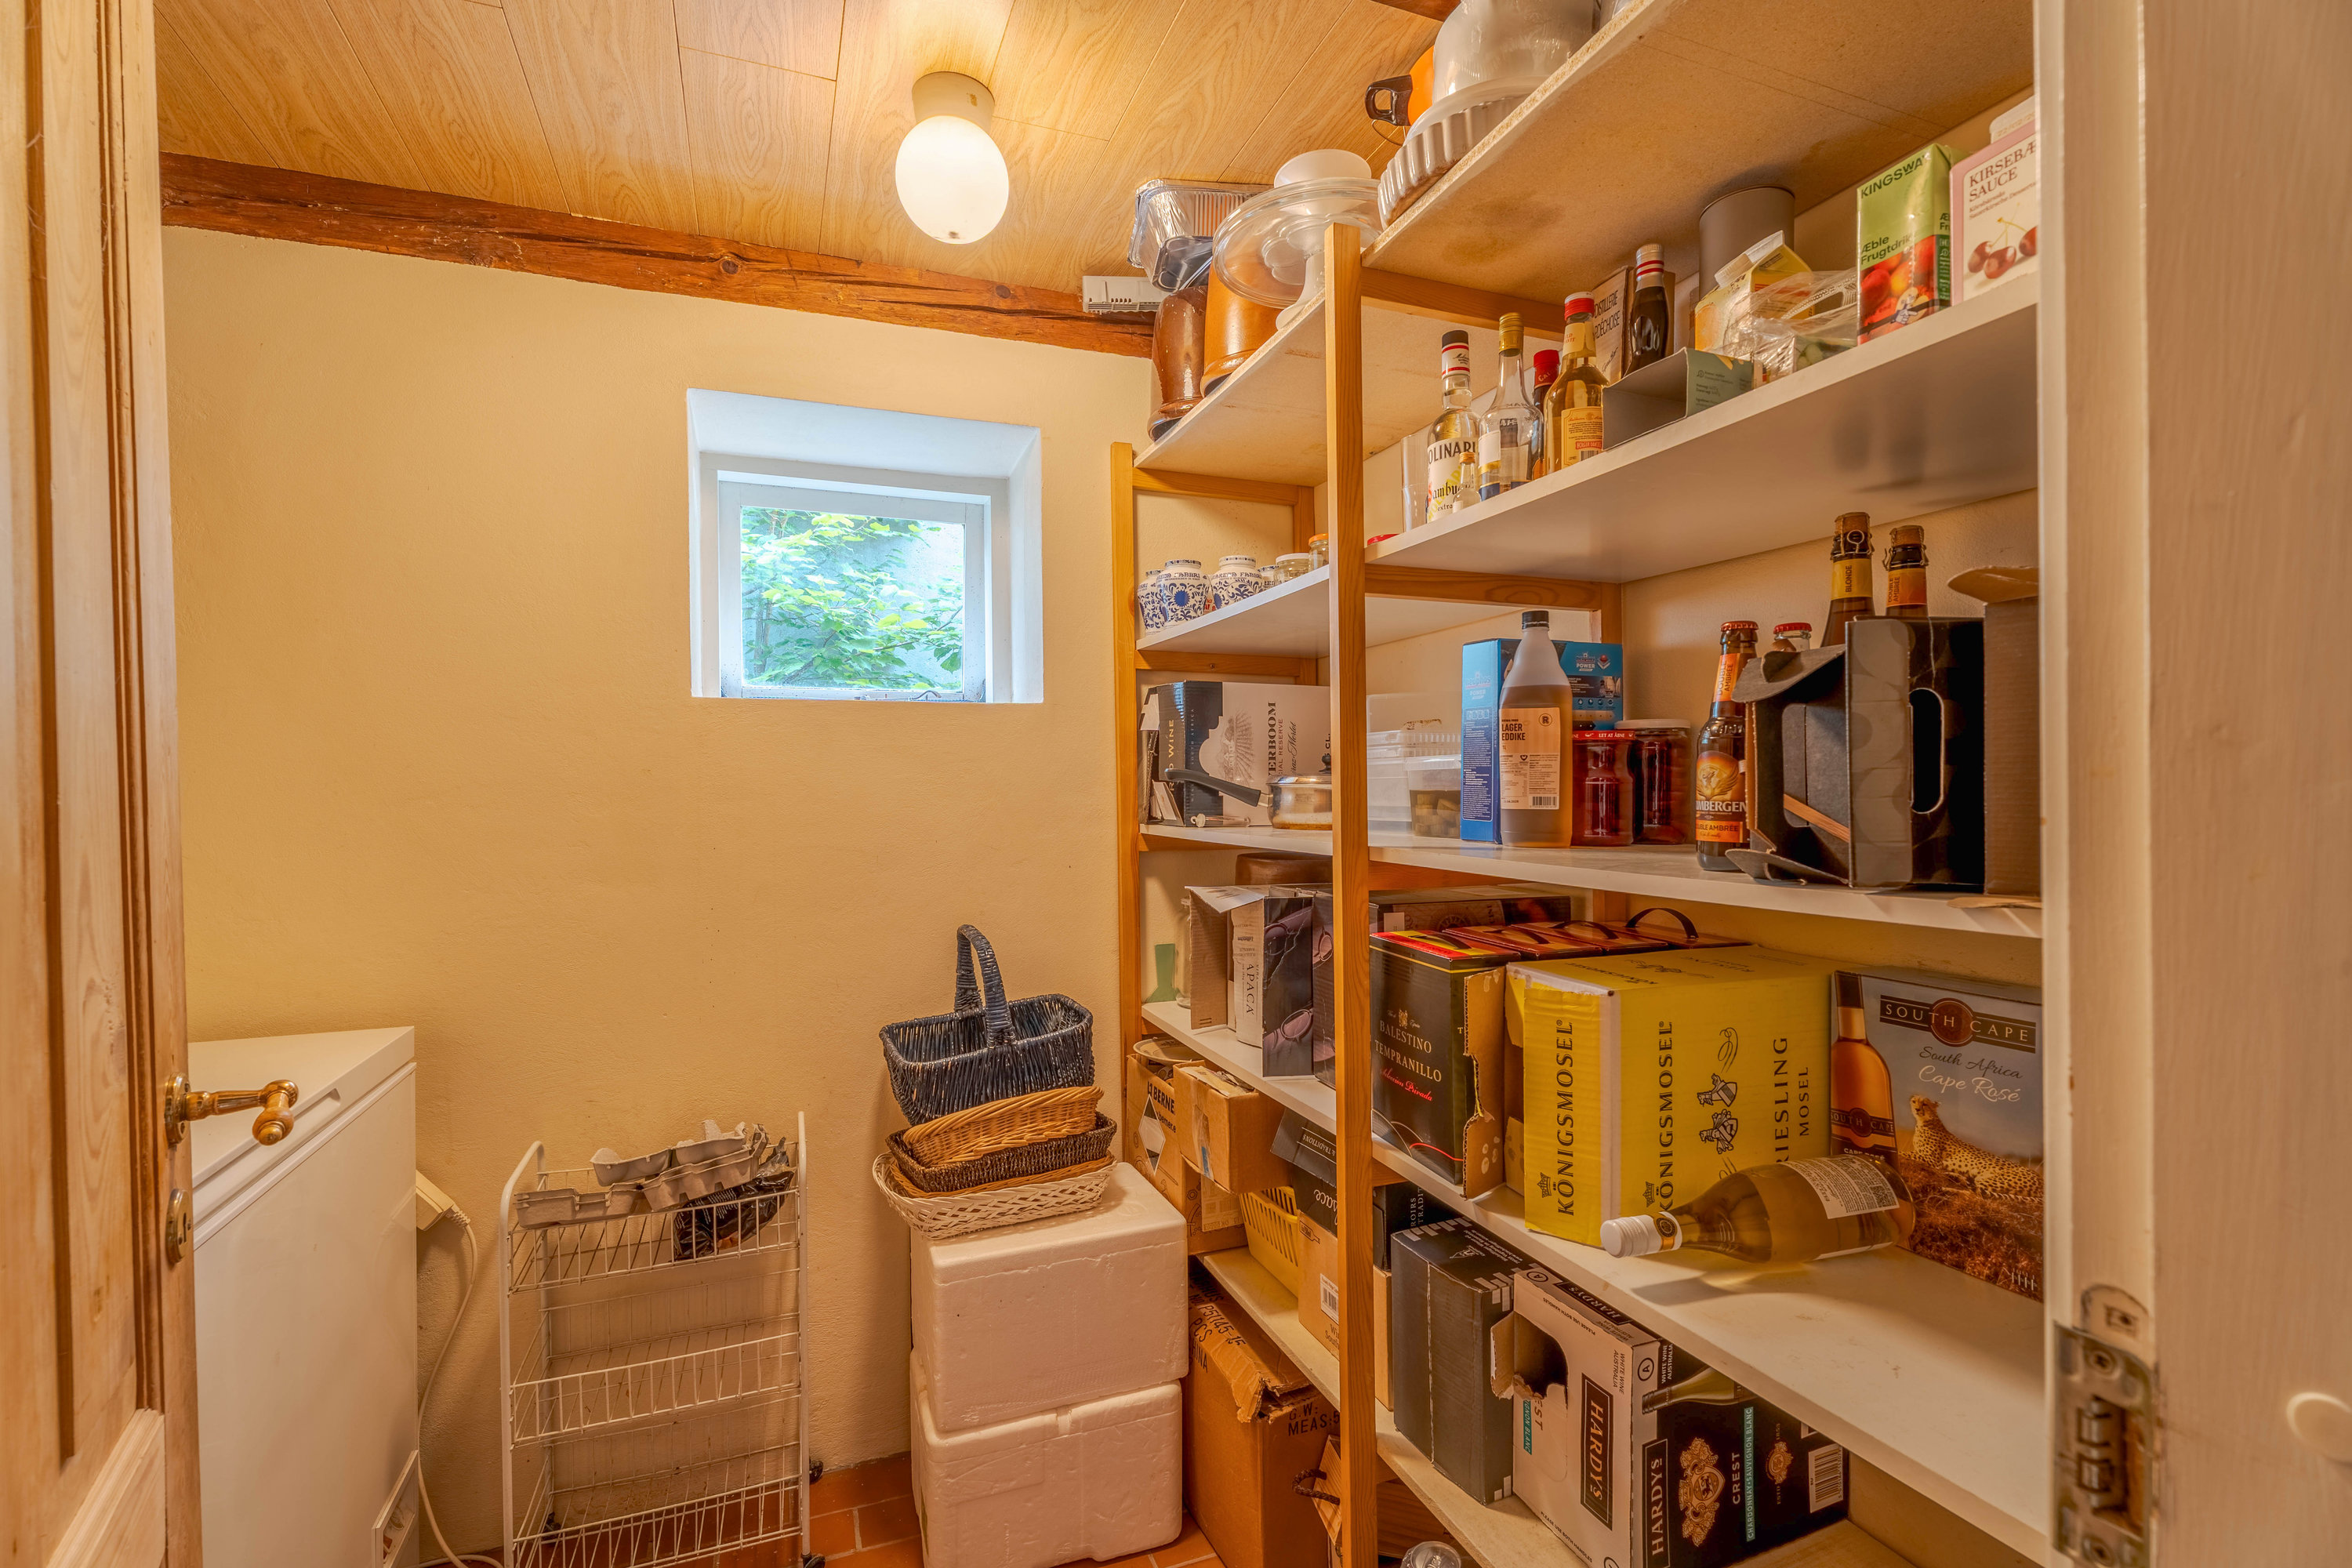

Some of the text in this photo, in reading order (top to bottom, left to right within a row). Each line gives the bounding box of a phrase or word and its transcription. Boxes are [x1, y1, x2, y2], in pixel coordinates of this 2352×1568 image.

[1969, 140, 2036, 187] KIRSEBÆ
[1969, 166, 2018, 202] SAUCE
[1860, 234, 1911, 266] Frugtdrik
[1861, 236, 1889, 255] Æble
[1428, 441, 1475, 464] OLINARI
[1428, 481, 1461, 507] Sambu
[1437, 503, 1454, 512] extra
[1501, 723, 1523, 732] LAGER
[1501, 732, 1526, 741] EDDIKE
[1380, 1020, 1432, 1054] BALESTINO
[1885, 1004, 2030, 1043] SOUTH CAPE
[1374, 1040, 1442, 1083] TEMPRANILLO
[1919, 1046, 2024, 1080] South Africa
[1918, 1065, 2021, 1102] Cape Rosé
[1153, 1086, 1175, 1115] BERNE
[1798, 1067, 1809, 1136] MOSEL
[1831, 1112, 1894, 1132] SOUTH CAPE
[1302, 1134, 1332, 1155] TRADITIONS
[1189, 1317, 1213, 1343] PCS
[1534, 1399, 1544, 1431] EST
[1589, 1399, 1604, 1501] HARDYS
[1732, 1453, 1741, 1504] CREST
[1650, 1457, 1665, 1556] HARDYS
[1541, 1511, 1555, 1526] PLEASE
[1562, 1531, 1573, 1545] BOTH
[1573, 1542, 1593, 1563] HANDLES
